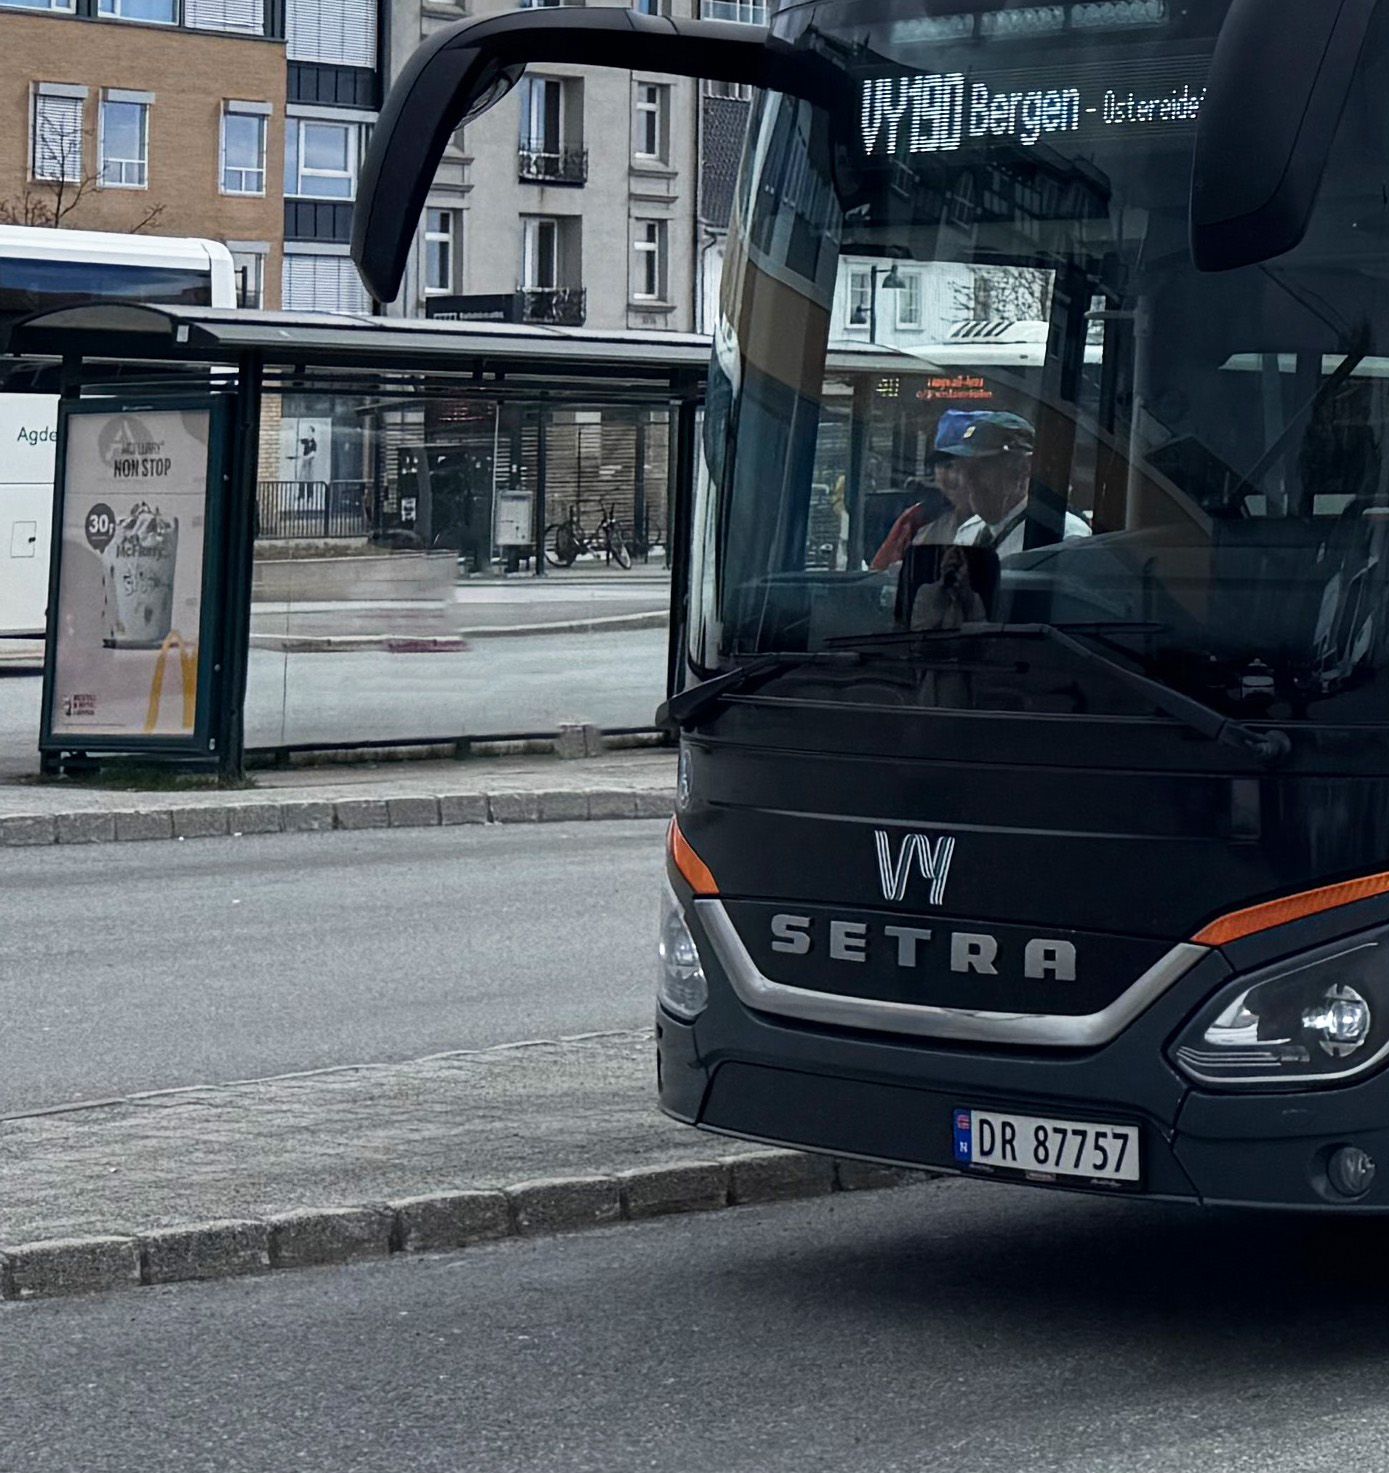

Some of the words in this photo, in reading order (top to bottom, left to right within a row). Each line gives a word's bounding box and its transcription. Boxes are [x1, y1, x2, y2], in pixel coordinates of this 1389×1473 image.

[860, 73, 966, 156] VY190
[969, 82, 1080, 146] Bergen
[1102, 84, 1207, 124] Ostereide
[17, 425, 58, 446] Agde
[113, 458, 139, 478] NON
[141, 457, 172, 477] STOP
[771, 913, 1077, 982] SETRA
[978, 1118, 1018, 1162] DR
[1033, 1125, 1130, 1174] 87757
